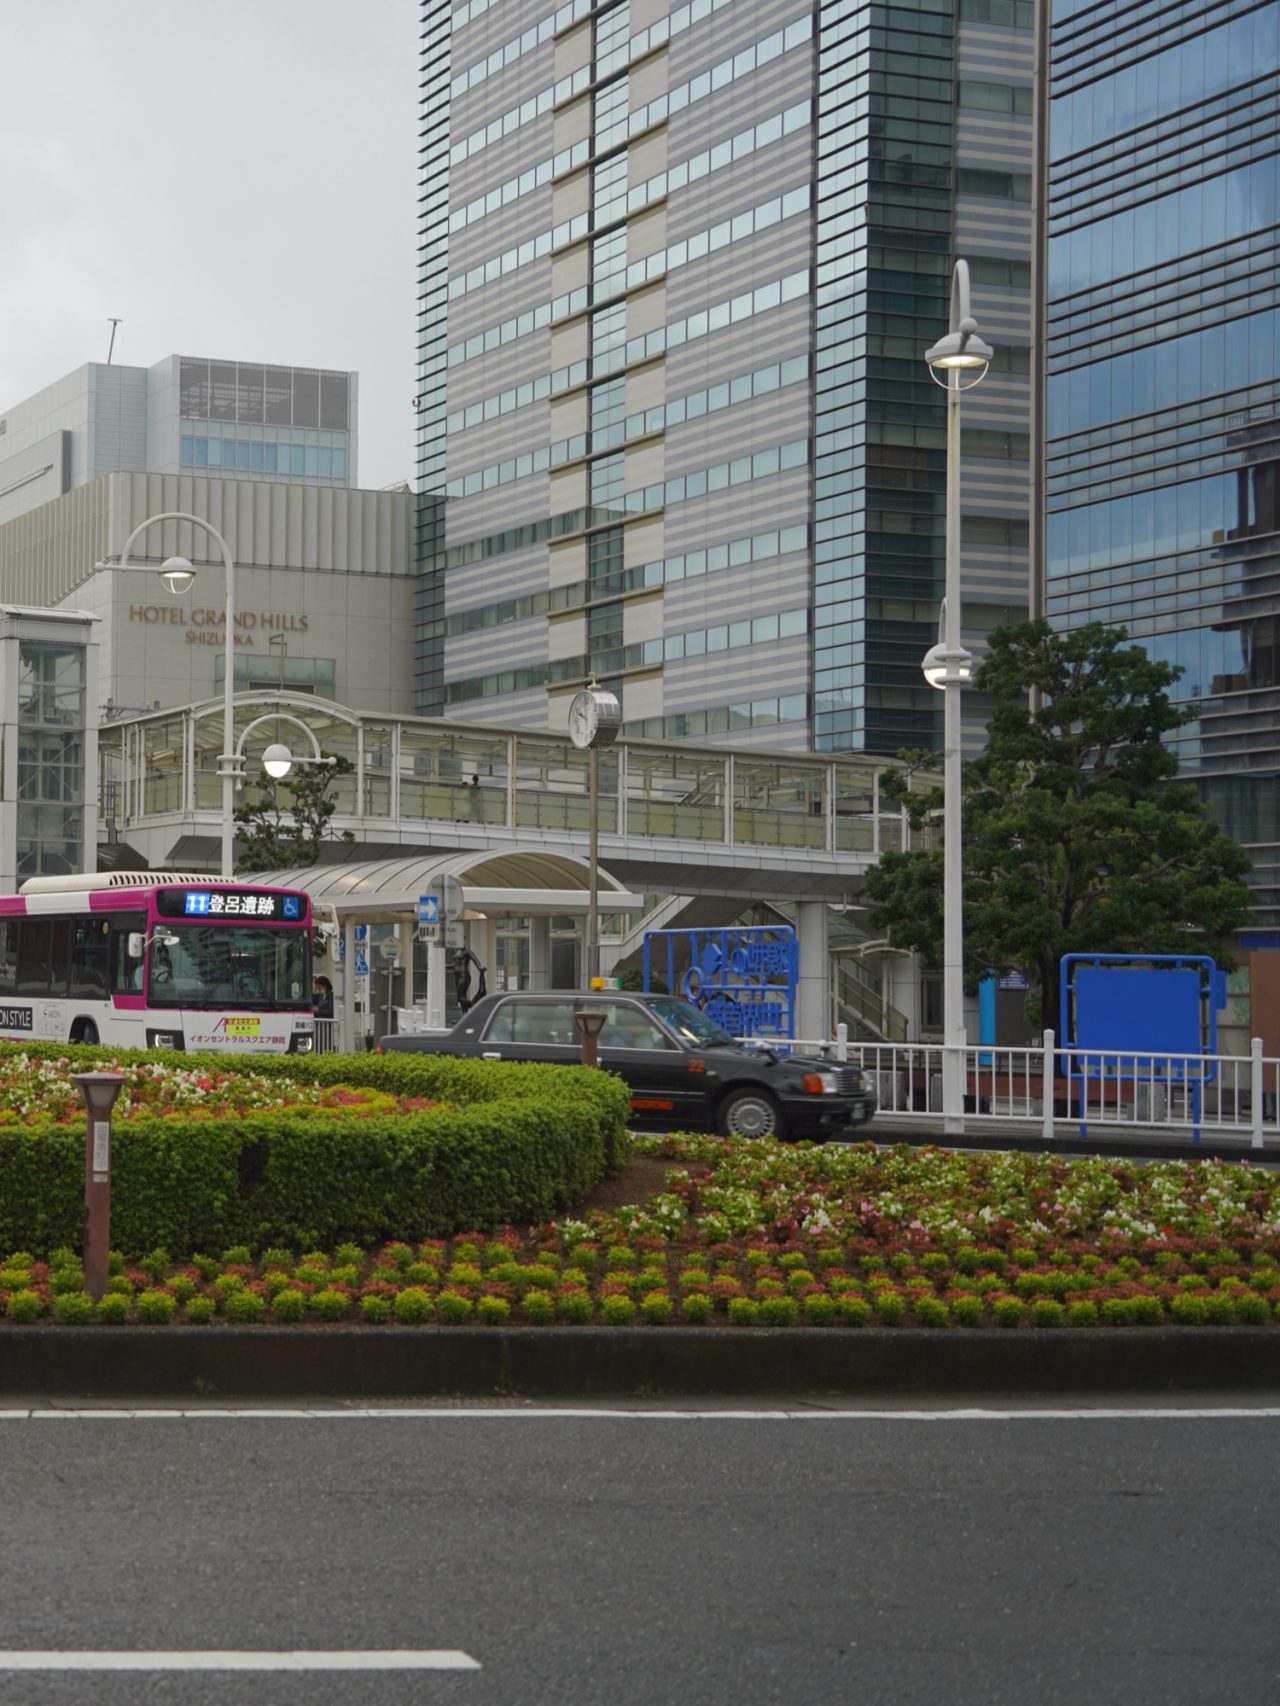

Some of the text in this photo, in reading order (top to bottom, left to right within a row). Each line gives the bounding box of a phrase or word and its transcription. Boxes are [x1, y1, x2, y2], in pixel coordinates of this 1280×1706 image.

[128, 604, 309, 632] HOTEL GRAND HILLS
[188, 894, 275, 915] 11 登呂遺跡
[10, 1010, 31, 1027] STYLE
[189, 1035, 286, 1044] イオンセントラルスクエア静岡
[688, 1058, 704, 1072] 22
